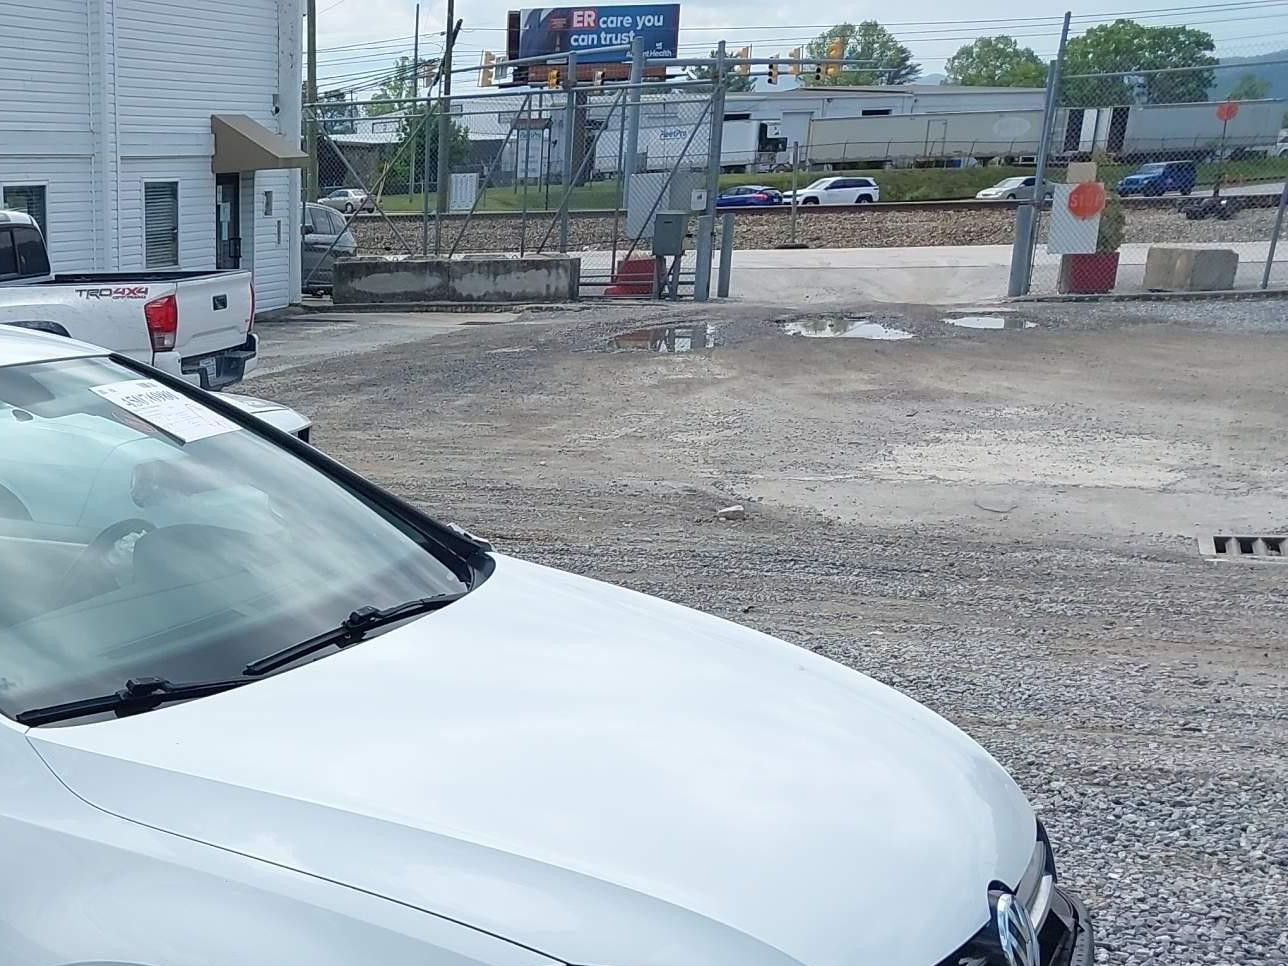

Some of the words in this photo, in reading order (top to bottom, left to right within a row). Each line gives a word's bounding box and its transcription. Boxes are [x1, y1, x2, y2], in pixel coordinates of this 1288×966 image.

[573, 11, 595, 27] ER
[599, 15, 632, 28] care
[636, 14, 664, 30] you
[570, 33, 598, 47] can
